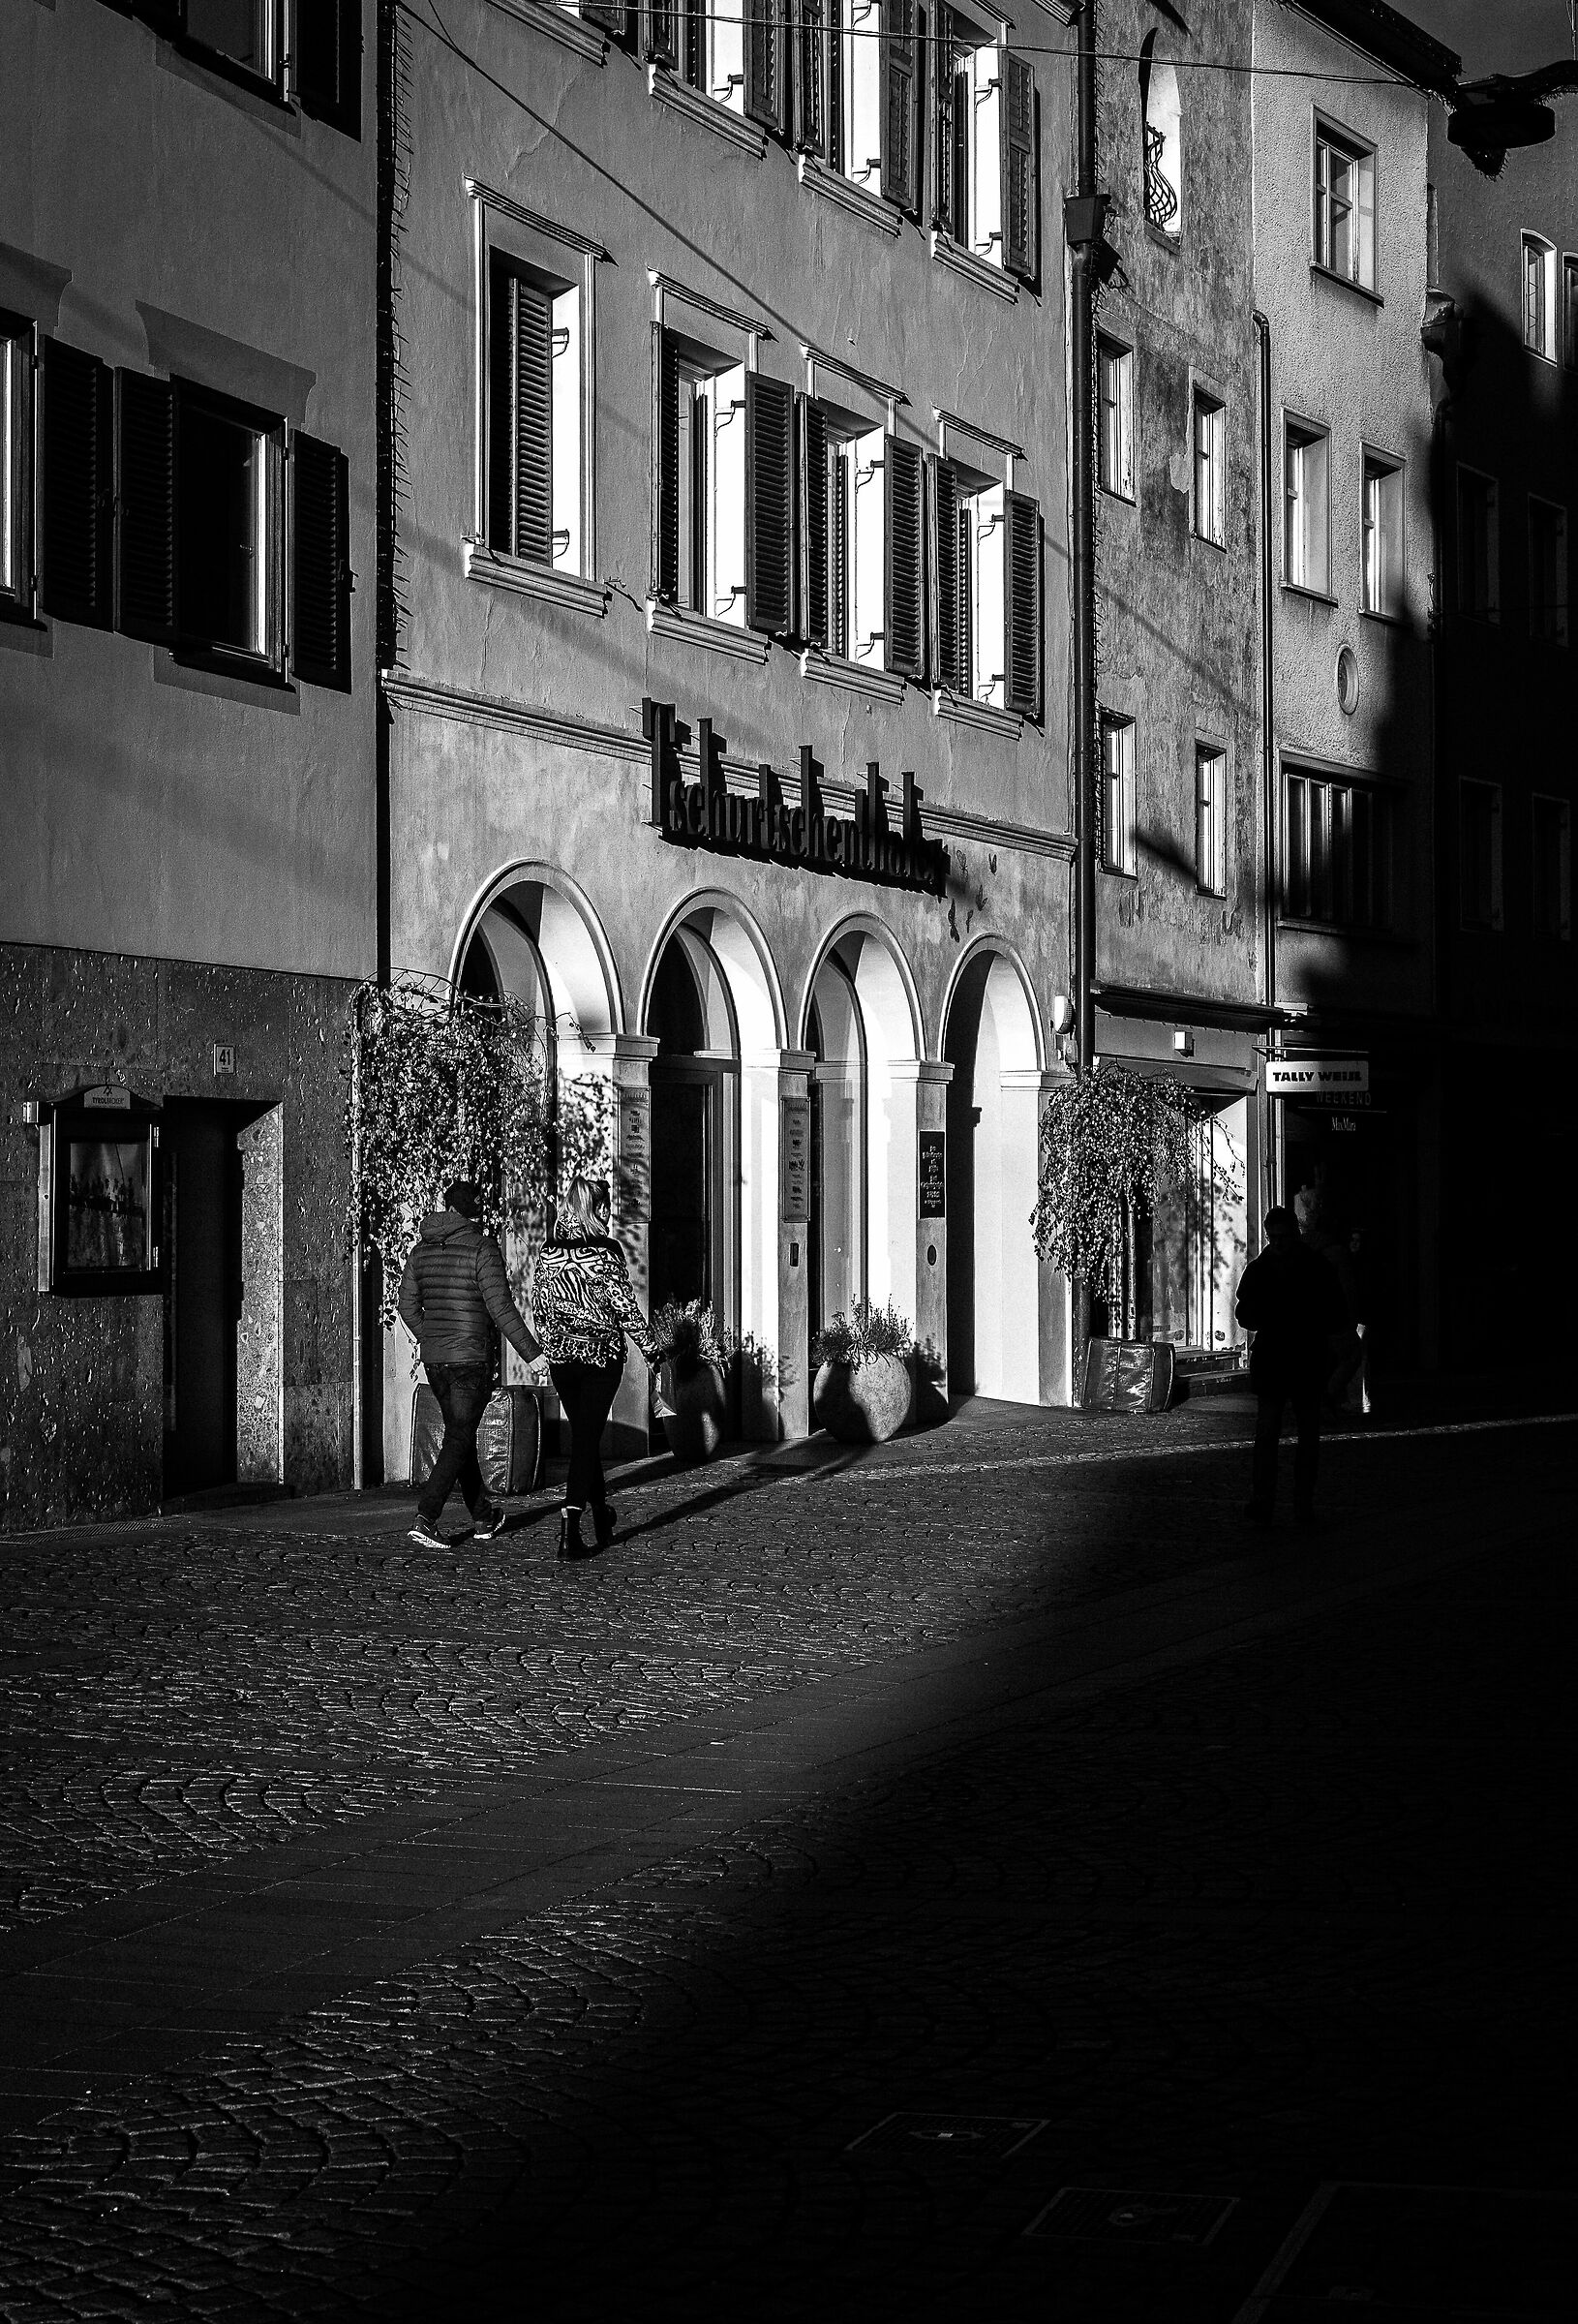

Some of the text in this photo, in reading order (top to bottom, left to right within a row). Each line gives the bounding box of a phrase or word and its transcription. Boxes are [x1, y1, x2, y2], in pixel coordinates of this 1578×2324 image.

[219, 1049, 230, 1065] 41
[1272, 1071, 1314, 1082] TALLY
[1316, 1091, 1371, 1106] WEEKEND
